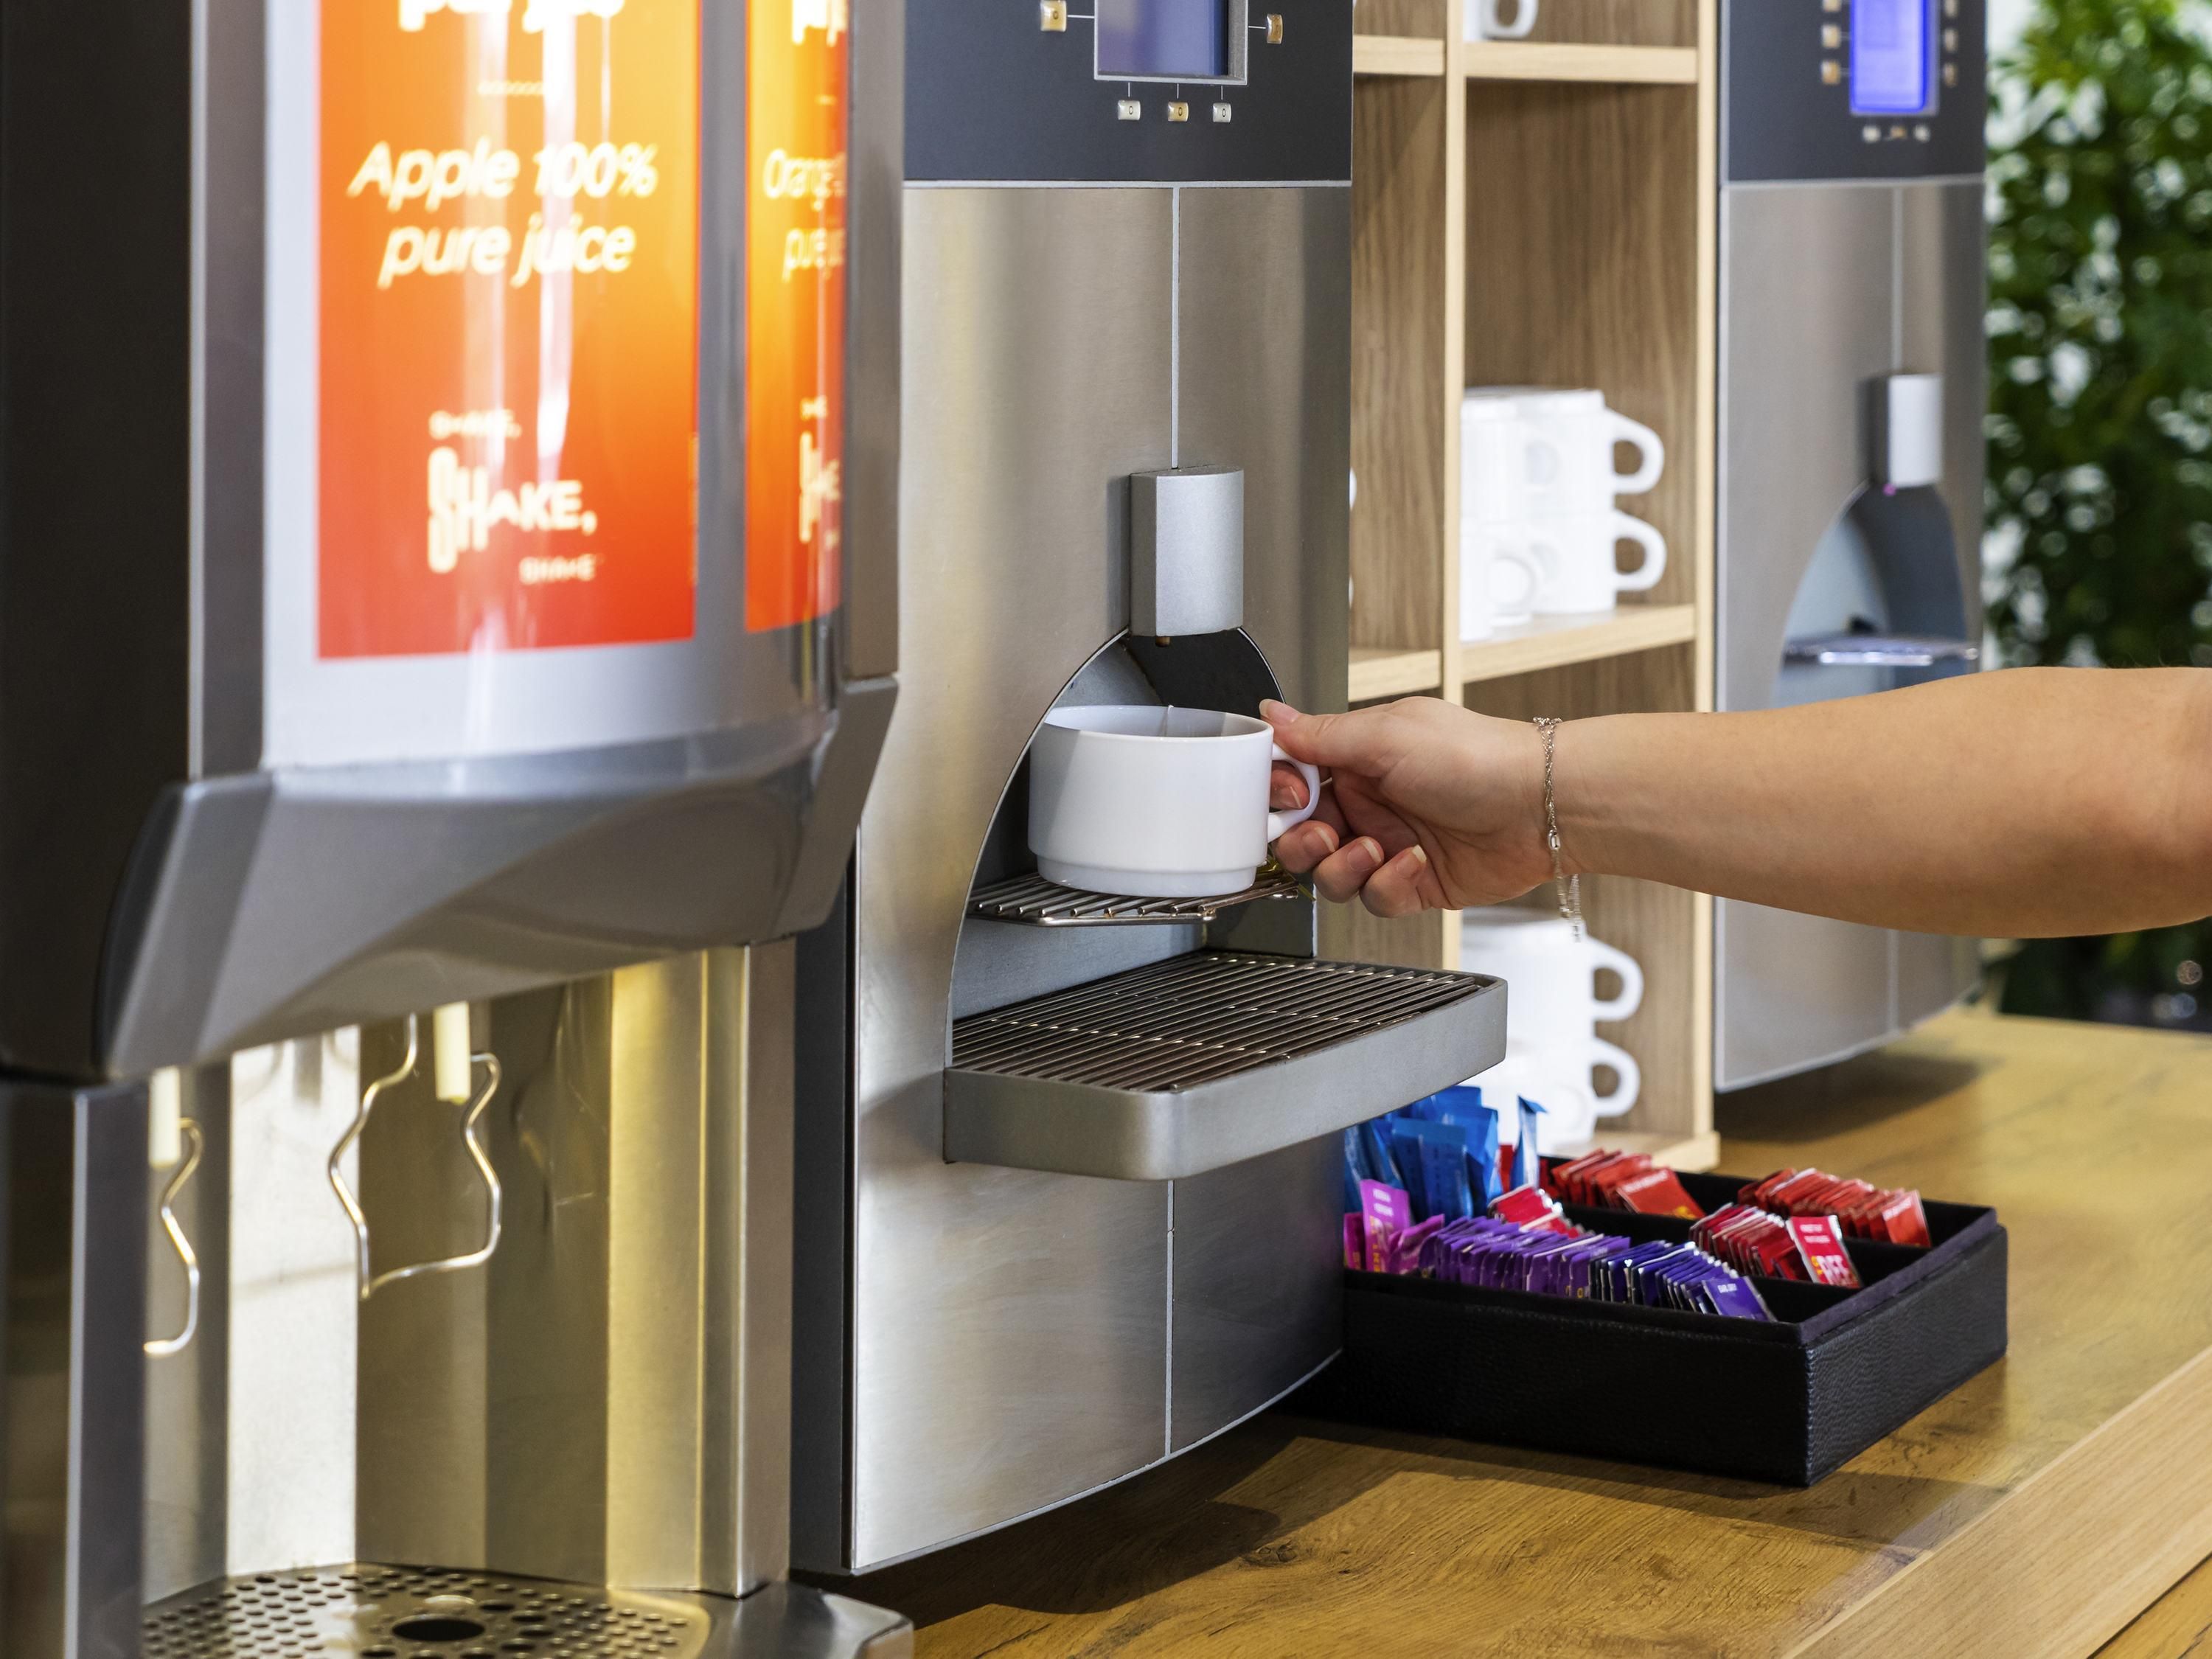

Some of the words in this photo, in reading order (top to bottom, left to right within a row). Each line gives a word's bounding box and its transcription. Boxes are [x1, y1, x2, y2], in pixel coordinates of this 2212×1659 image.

[347, 136, 520, 212] Apple
[532, 142, 658, 198] 100%
[377, 225, 511, 291] pure
[510, 213, 636, 288] juice
